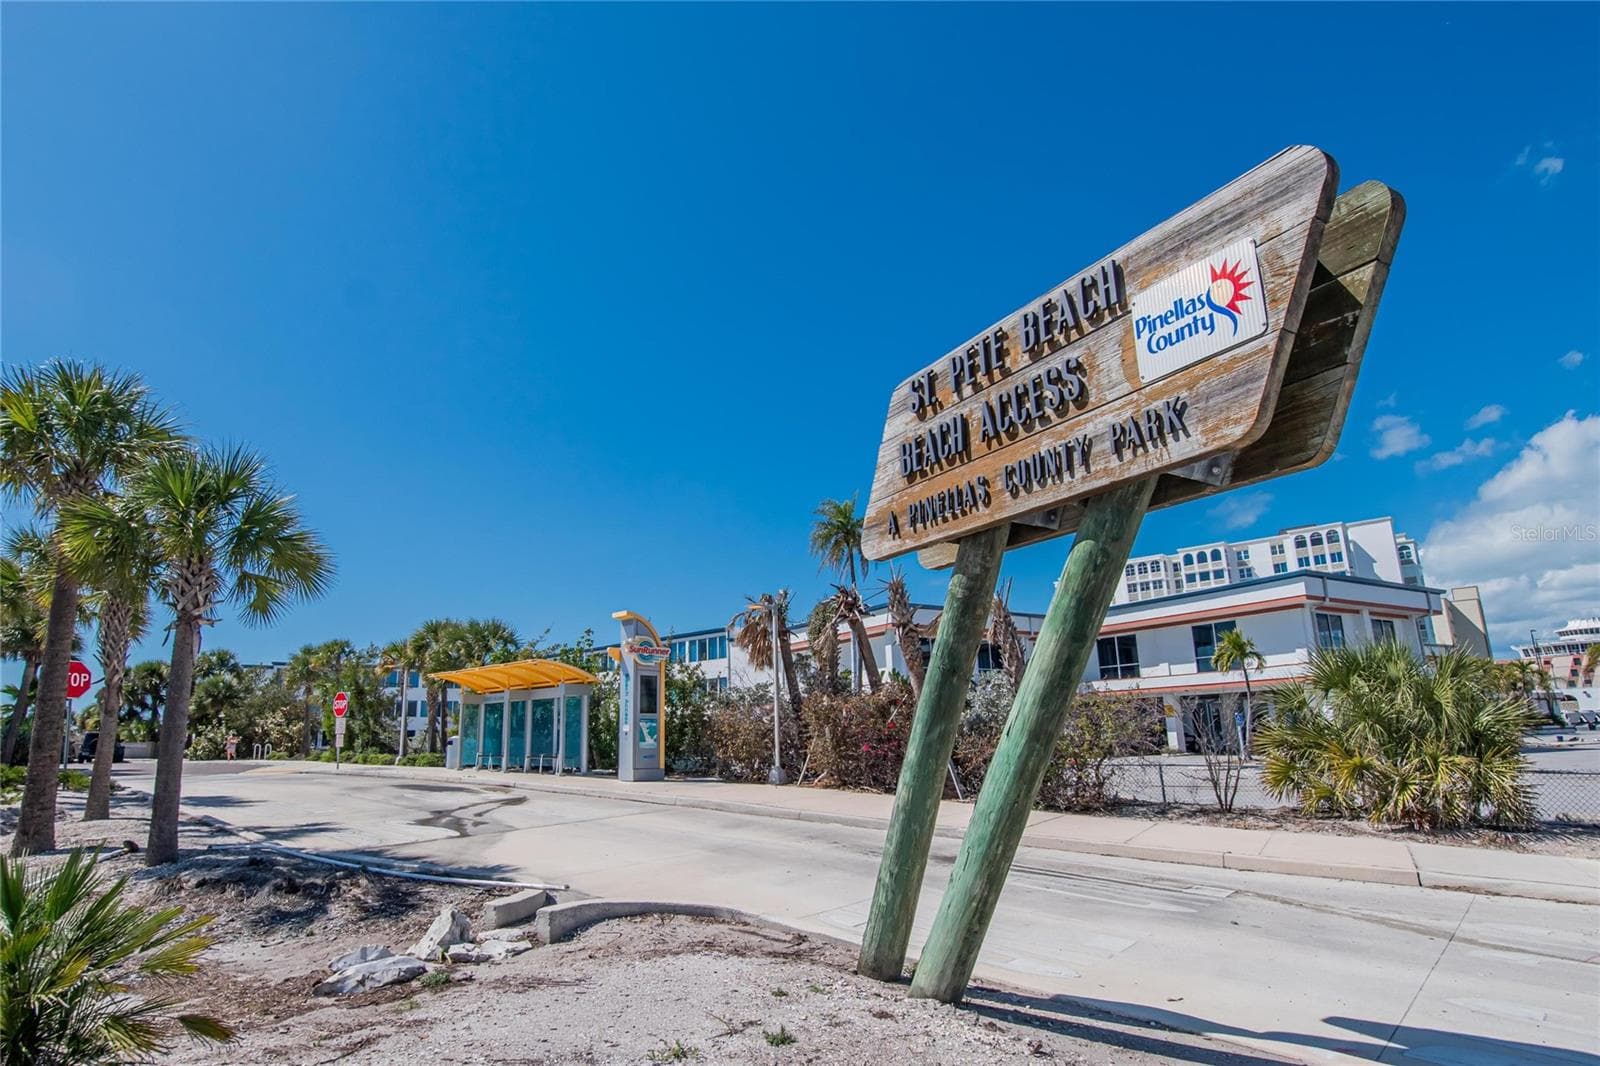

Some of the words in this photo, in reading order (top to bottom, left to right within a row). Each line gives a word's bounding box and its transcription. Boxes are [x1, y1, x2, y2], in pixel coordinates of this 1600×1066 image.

[908, 369, 939, 414] ST.
[949, 327, 1004, 394] PETE
[1019, 259, 1119, 354] BEACH
[1135, 293, 1206, 340] Pinellas
[1147, 312, 1216, 354] County
[900, 412, 968, 478] BEACH
[979, 356, 1081, 443] ACCESS
[888, 510, 899, 535] A
[907, 475, 988, 528] PINELLAS
[1003, 433, 1088, 492] COUNTY
[1108, 396, 1183, 456] PARK
[68, 672, 90, 687] OP
[334, 700, 347, 709] STOP
